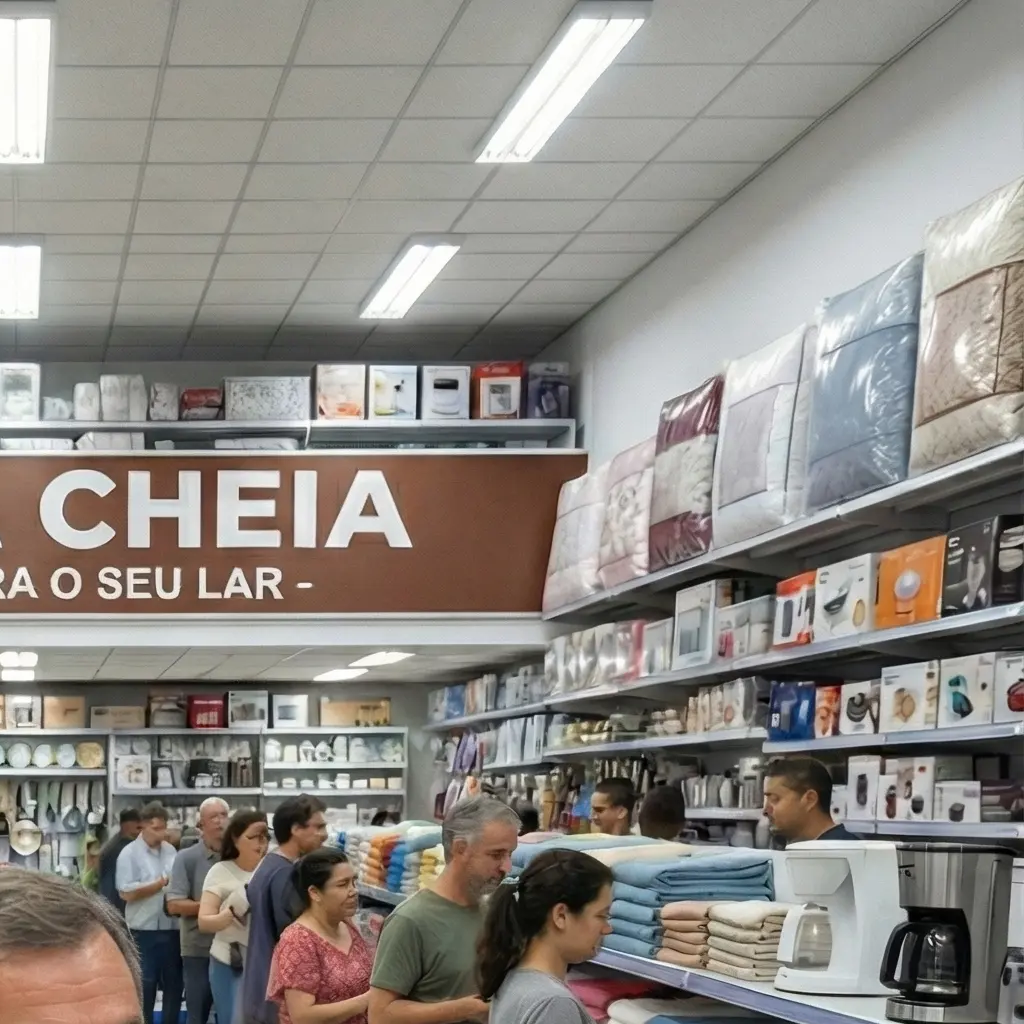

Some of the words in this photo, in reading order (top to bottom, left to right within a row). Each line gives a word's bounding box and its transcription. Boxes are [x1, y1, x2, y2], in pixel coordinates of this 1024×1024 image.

[39, 469, 413, 550] CHEIA
[50, 566, 82, 600] O
[97, 566, 182, 600] SEU
[198, 566, 284, 600] LAR
